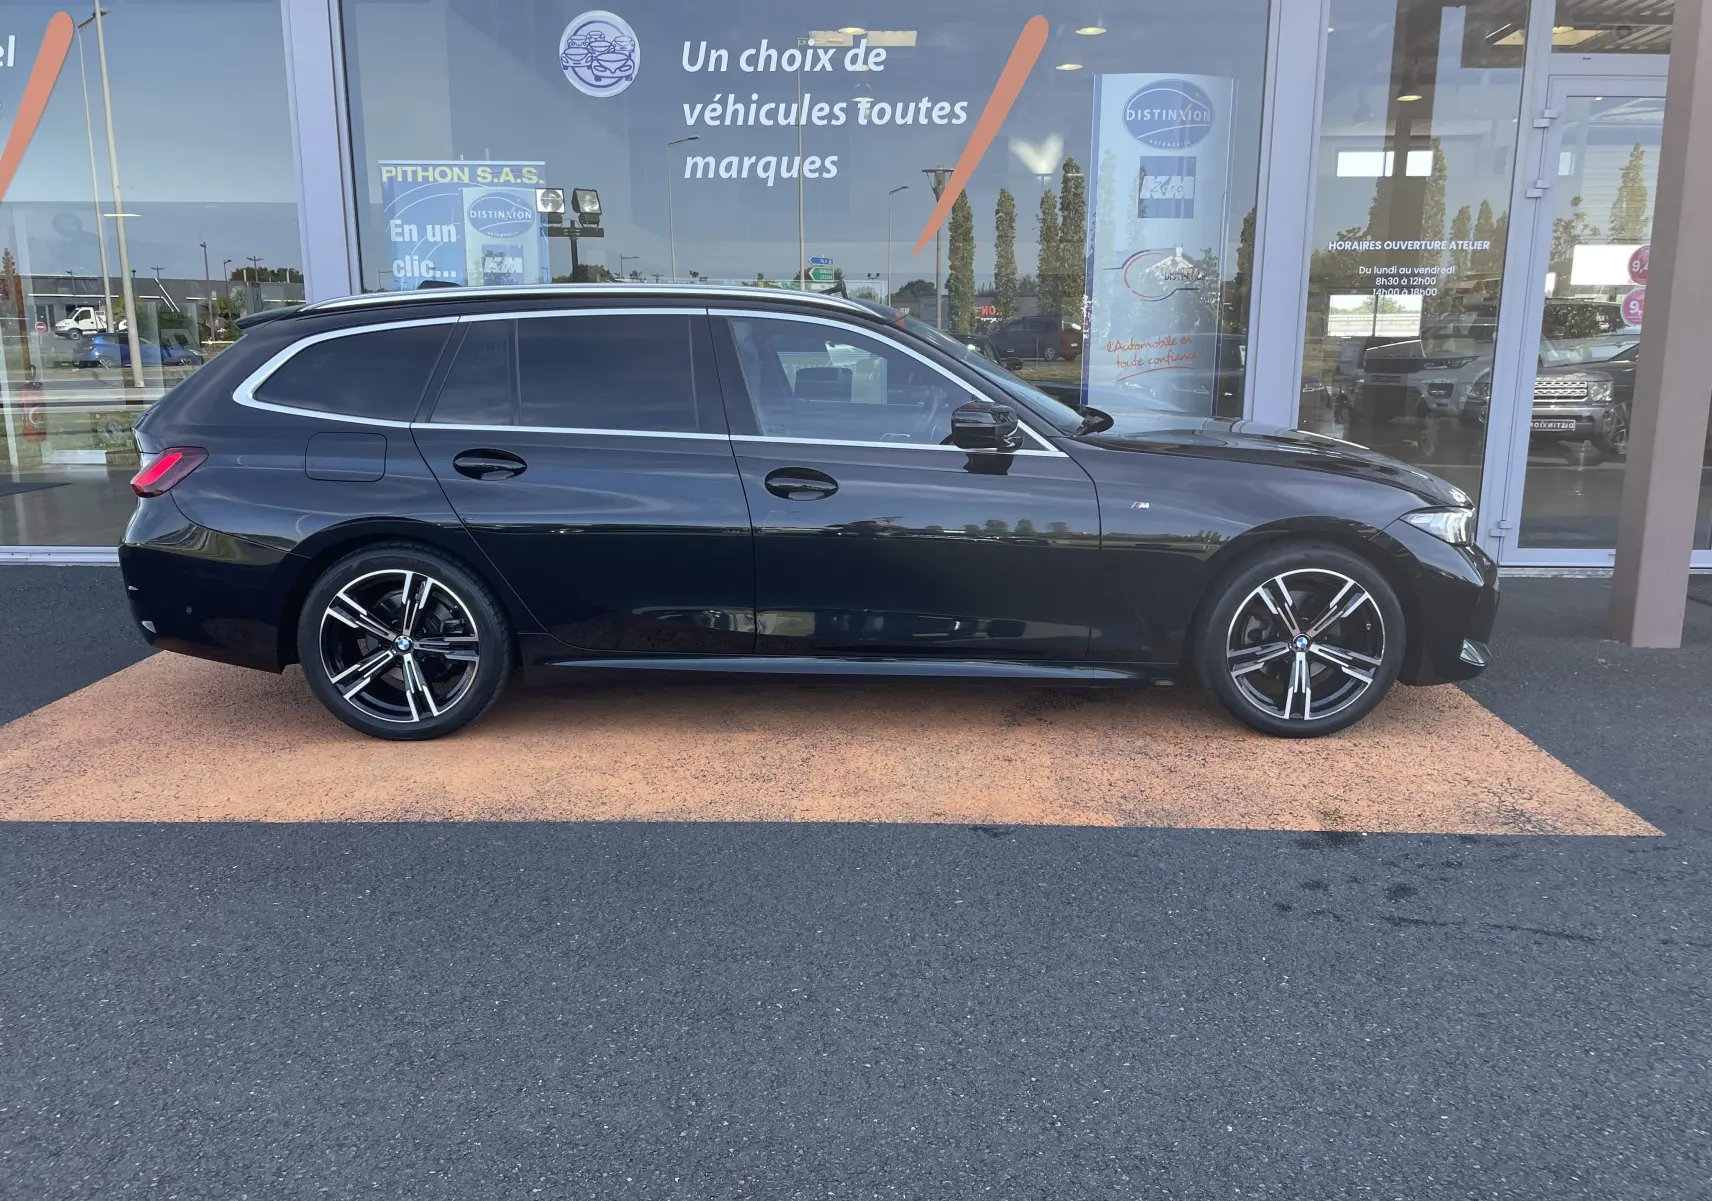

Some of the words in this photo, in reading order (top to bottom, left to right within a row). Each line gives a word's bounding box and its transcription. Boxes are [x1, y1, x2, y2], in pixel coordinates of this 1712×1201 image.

[681, 40, 729, 72] Un
[739, 38, 837, 72] choix
[844, 38, 887, 72] de
[683, 93, 847, 126] véhicules
[857, 96, 969, 126] toutes
[1126, 109, 1211, 122] DISTINXION
[381, 166, 470, 183] PITHON
[476, 166, 545, 184] S.A.S.
[684, 154, 839, 187] marques
[470, 209, 532, 219] DISTINXION
[389, 219, 418, 242] En
[426, 223, 457, 243] un
[1328, 241, 1382, 250] HORAIRES
[1383, 240, 1447, 250] OUVERTURE
[1448, 240, 1491, 250] ATELIER
[392, 255, 457, 278] clic...
[1358, 266, 1371, 274] Du
[1373, 265, 1397, 274] lundi
[1413, 265, 1456, 274] vendredi
[1375, 277, 1399, 286] 8h30
[1401, 276, 1407, 286] à
[1409, 277, 1437, 286] 12h00
[1116, 353, 1144, 369] toute
[1148, 349, 1198, 366] confiance
